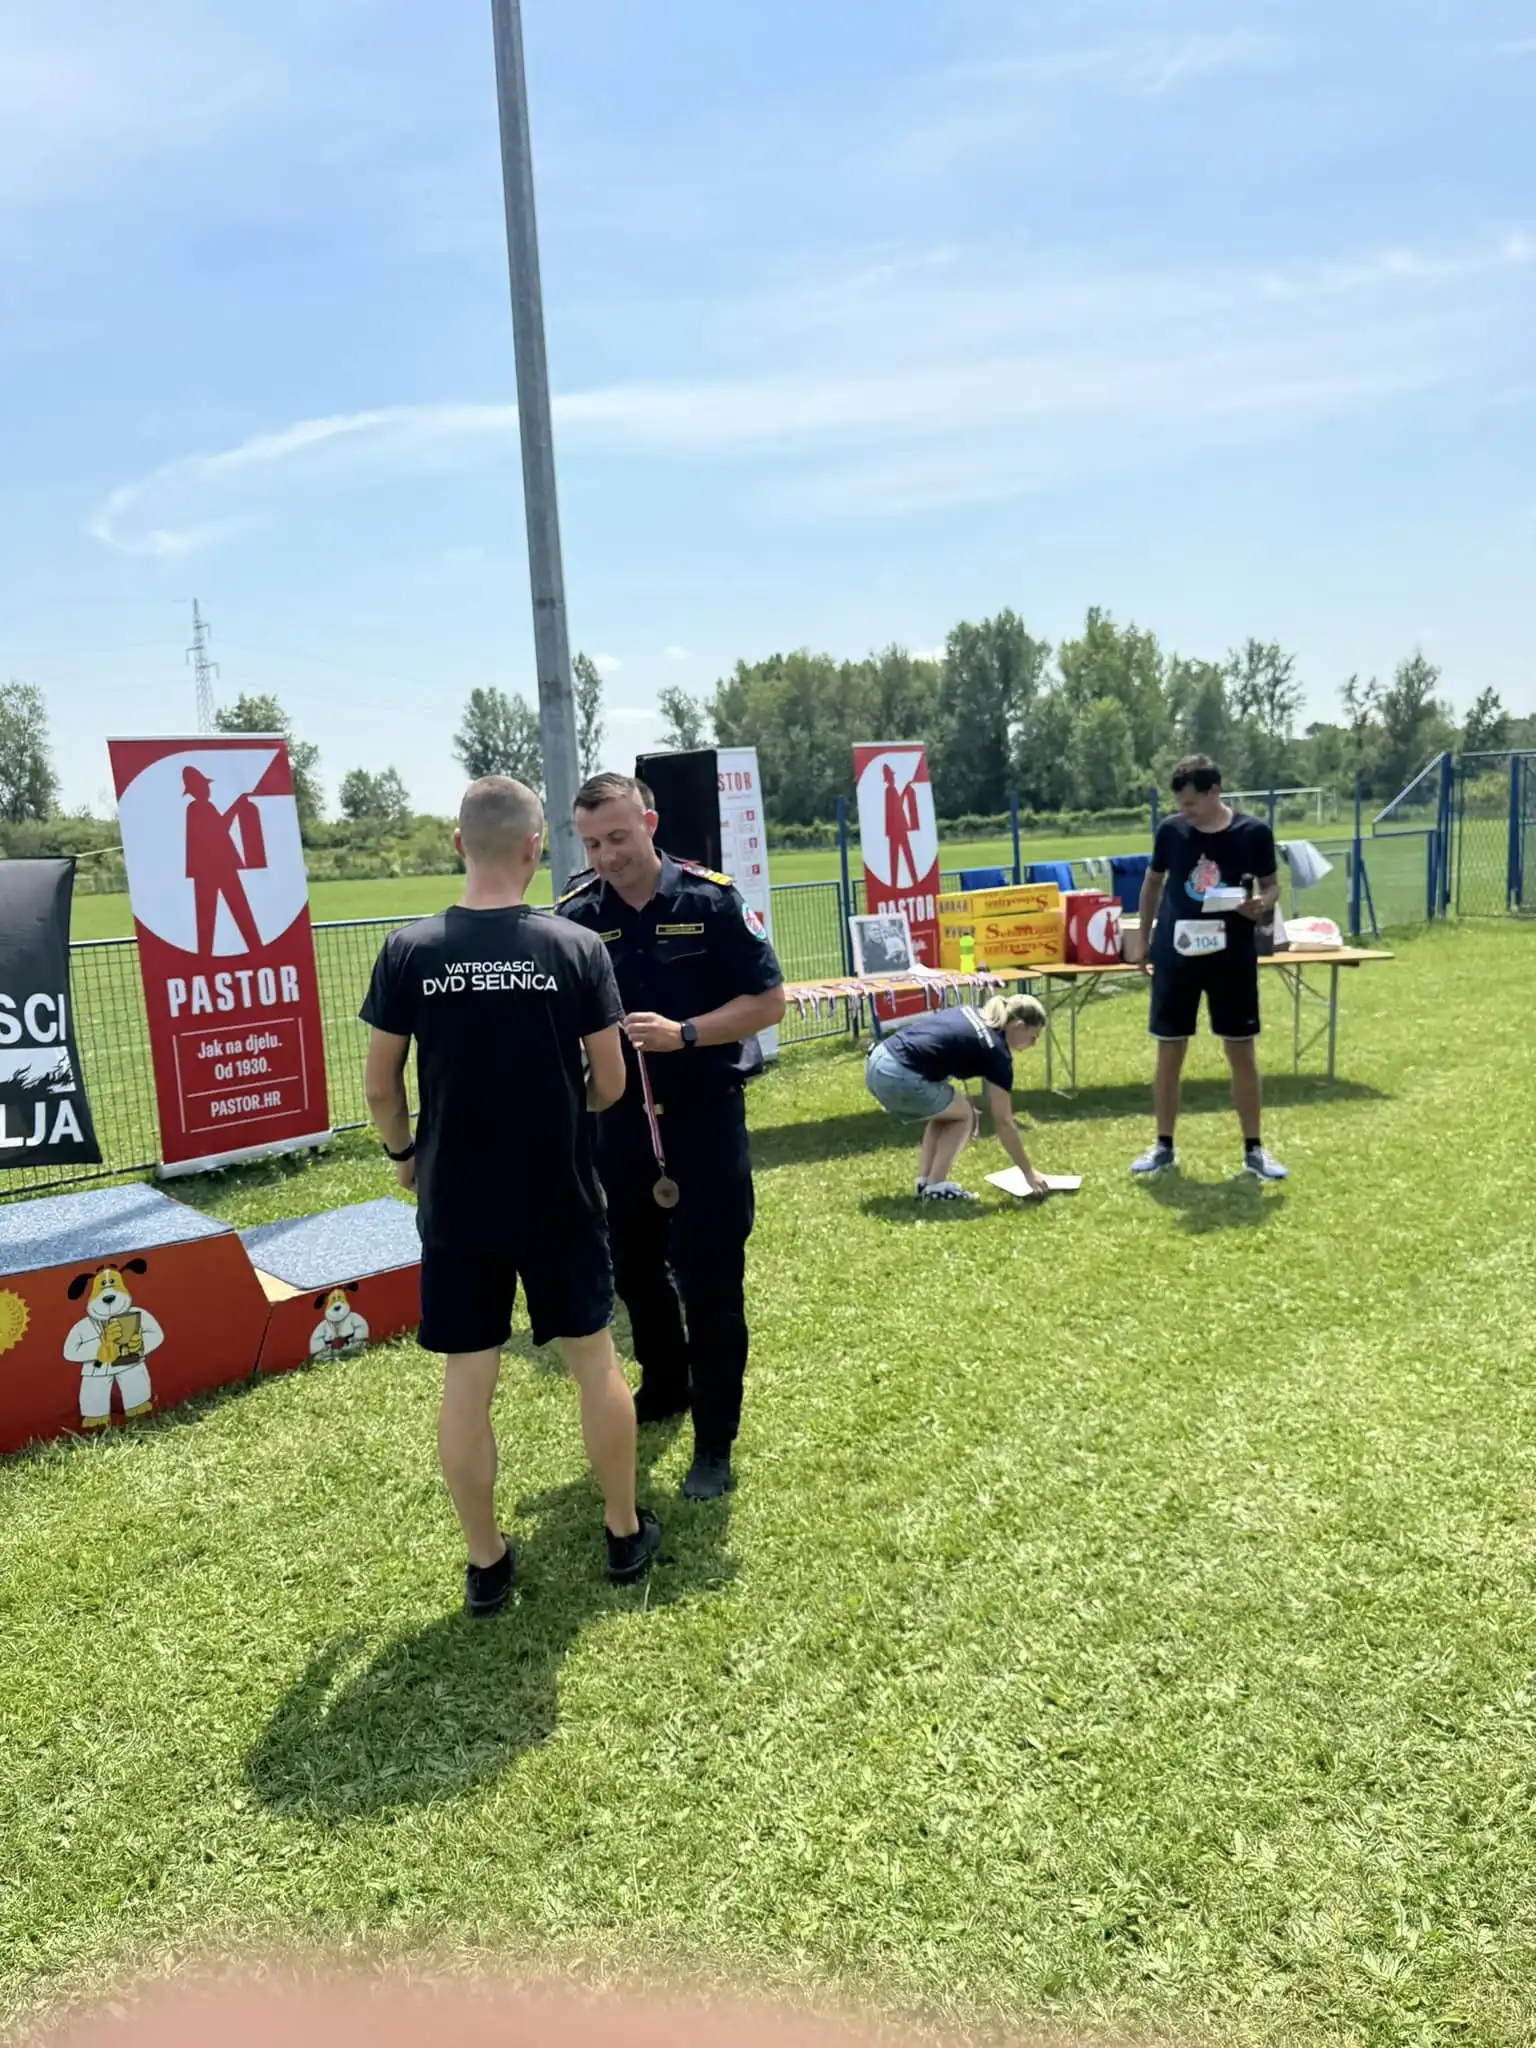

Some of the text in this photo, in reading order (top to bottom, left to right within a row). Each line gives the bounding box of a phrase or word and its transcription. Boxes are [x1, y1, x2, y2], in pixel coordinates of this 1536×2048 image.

[1194, 936, 1218, 949] 104
[444, 961, 534, 975] VATROGASCI
[166, 965, 300, 1018] PASTOR
[422, 973, 558, 996] DVD SELNICA
[197, 1032, 283, 1060] Jak na djelu.
[214, 1057, 272, 1080] Od 1930.
[210, 1090, 282, 1118] PASTOR.HR
[0, 1099, 84, 1149] LJA
